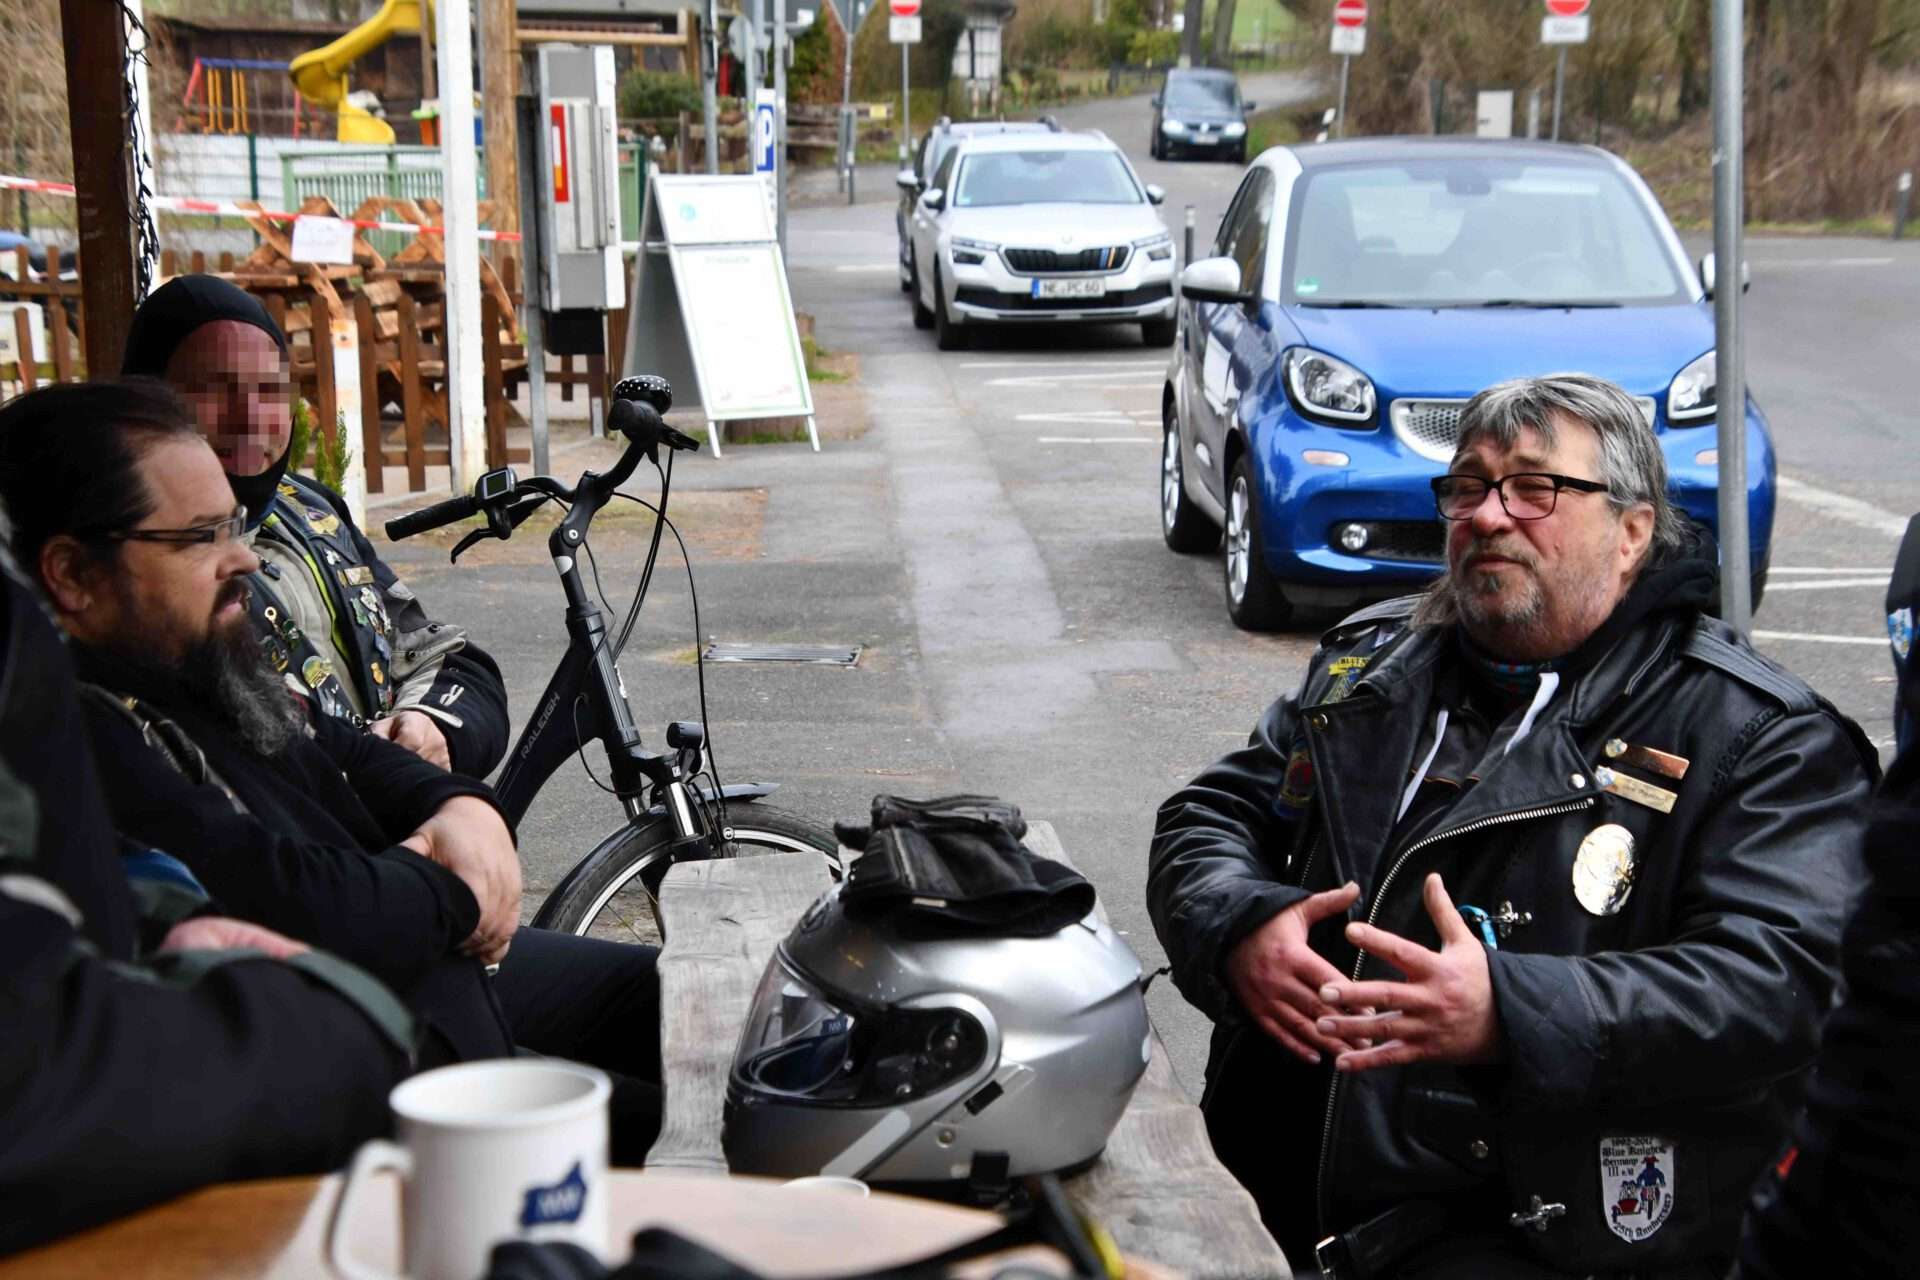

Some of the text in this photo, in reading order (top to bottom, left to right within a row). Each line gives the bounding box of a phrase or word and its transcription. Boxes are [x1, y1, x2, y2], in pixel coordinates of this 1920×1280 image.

[757, 108, 773, 167] P
[521, 691, 560, 759] RALEIGH
[1602, 1147, 1625, 1157] Blue
[1602, 1158, 1638, 1168] Germany
[1613, 1222, 1633, 1238] 25th
